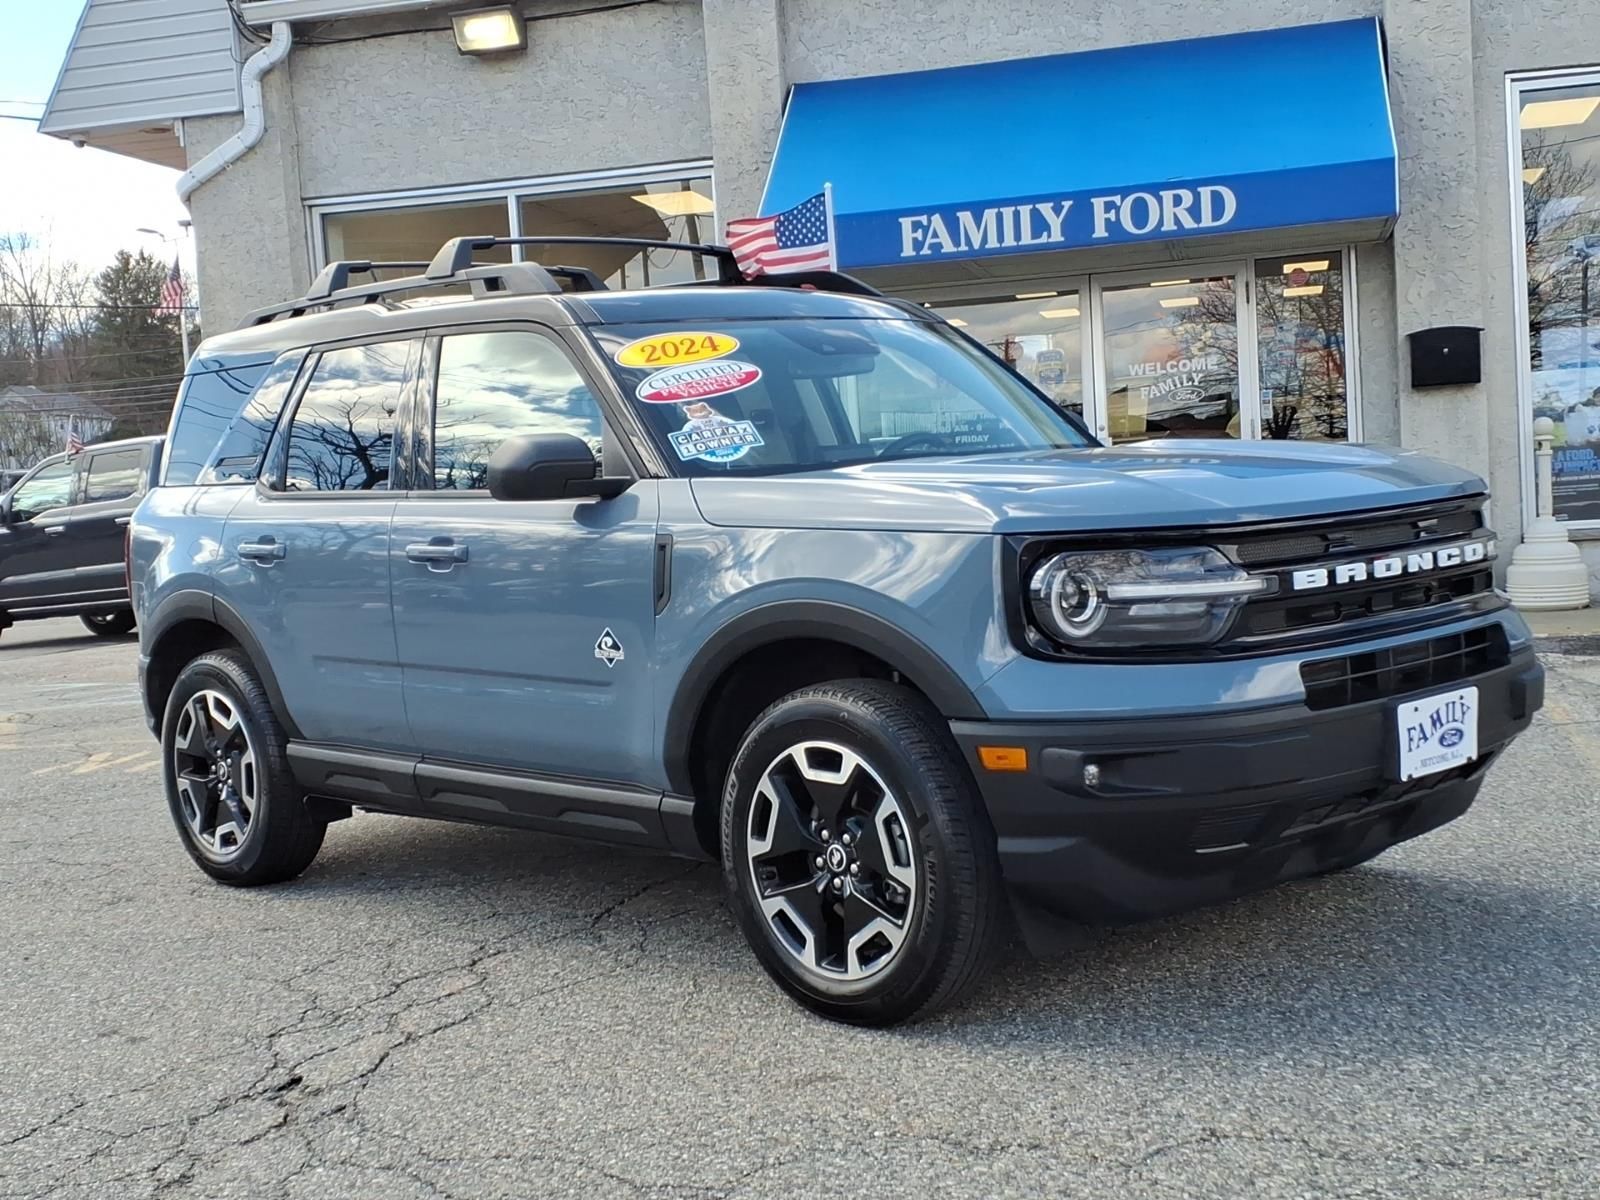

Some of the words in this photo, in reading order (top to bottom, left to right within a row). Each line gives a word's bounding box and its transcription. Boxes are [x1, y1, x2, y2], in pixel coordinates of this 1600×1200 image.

[898, 200, 1073, 257] FAMILY
[1091, 184, 1236, 239] FORD
[640, 335, 720, 363] 2024
[648, 362, 743, 389] CERTIFIED
[1128, 357, 1218, 376] WELCOME
[660, 372, 747, 397] PRE-OWNED
[679, 380, 741, 398] VEHICLE
[1140, 373, 1204, 399] FAMILY
[1175, 390, 1199, 401] Ford
[677, 424, 750, 444] CARFAX
[683, 446, 693, 454] 1
[695, 434, 755, 451] OWNER
[955, 434, 990, 444] FRIDAY
[1293, 542, 1484, 590] BRONCO
[1406, 701, 1471, 753] FAMILY
[723, 779, 736, 862] MICHELIN
